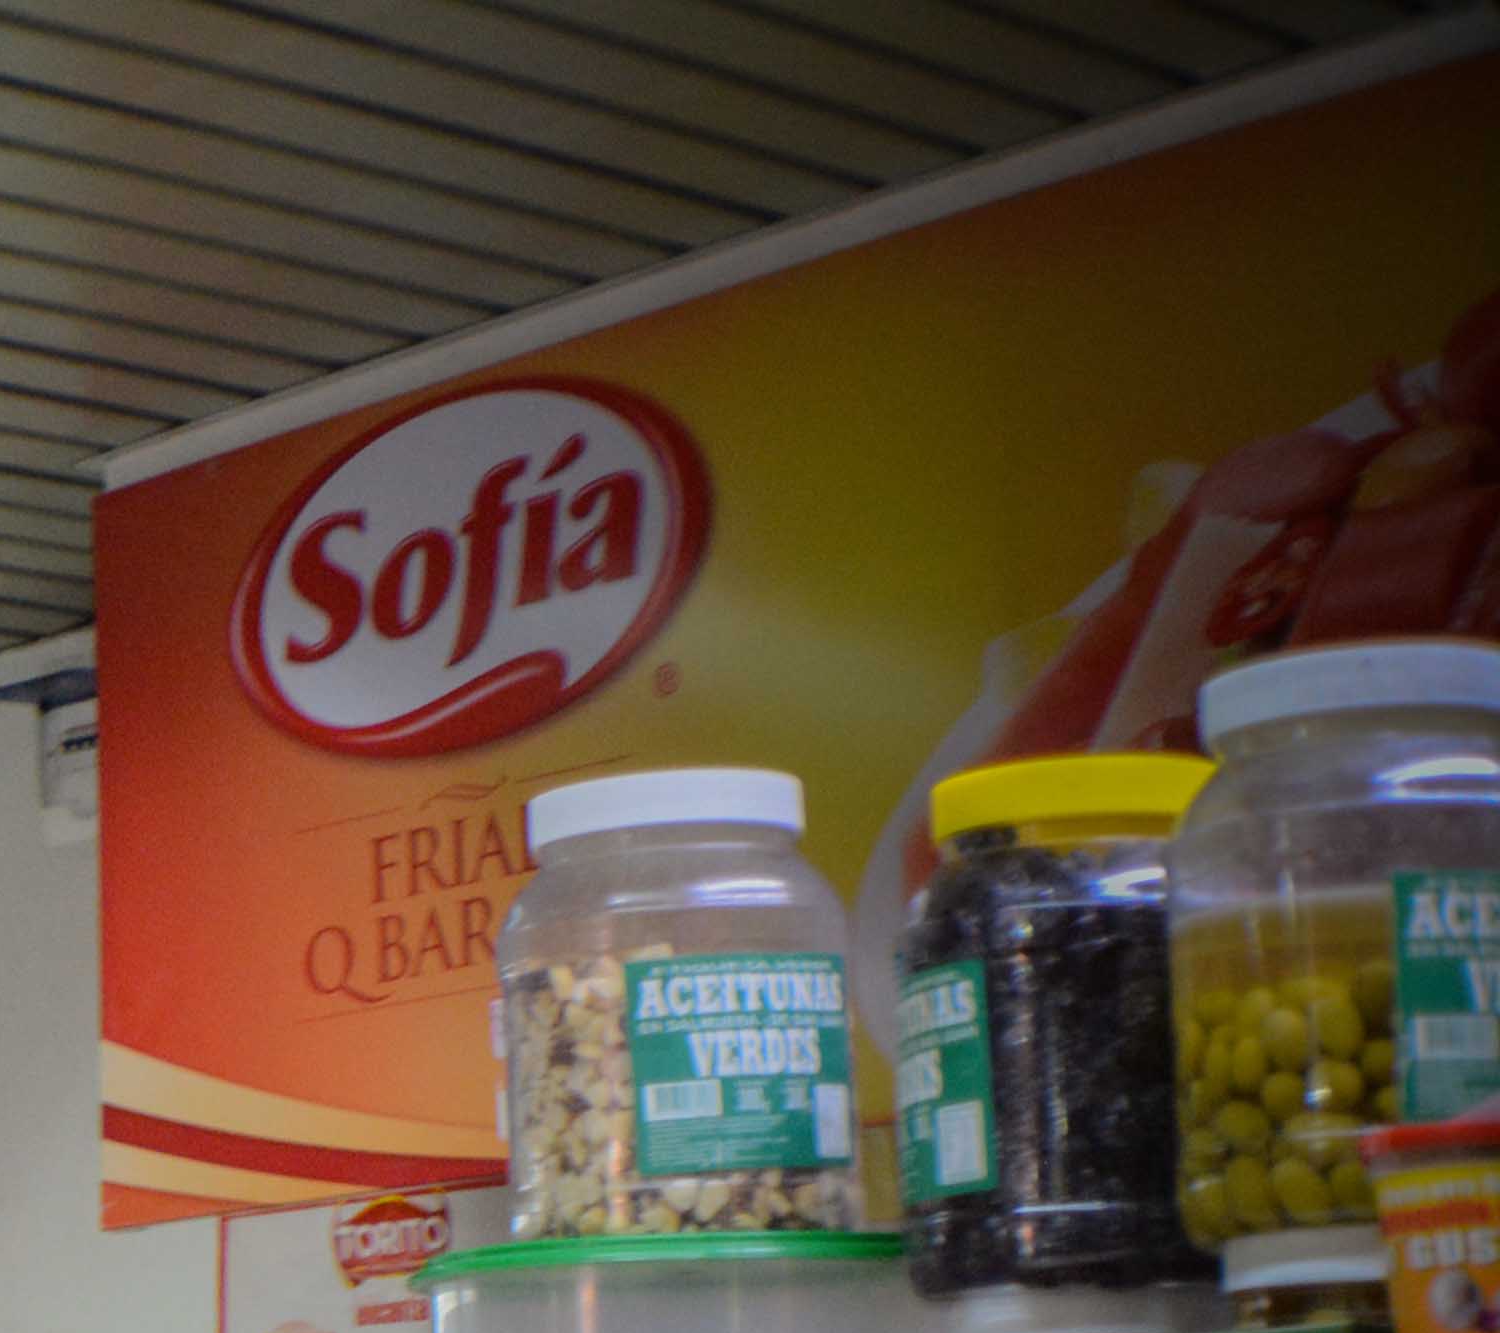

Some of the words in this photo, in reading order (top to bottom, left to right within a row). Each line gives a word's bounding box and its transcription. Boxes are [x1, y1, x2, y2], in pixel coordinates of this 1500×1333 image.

[286, 432, 645, 668] Sofía
[307, 925, 393, 1004] Q
[688, 1027, 822, 1078] VERDES
